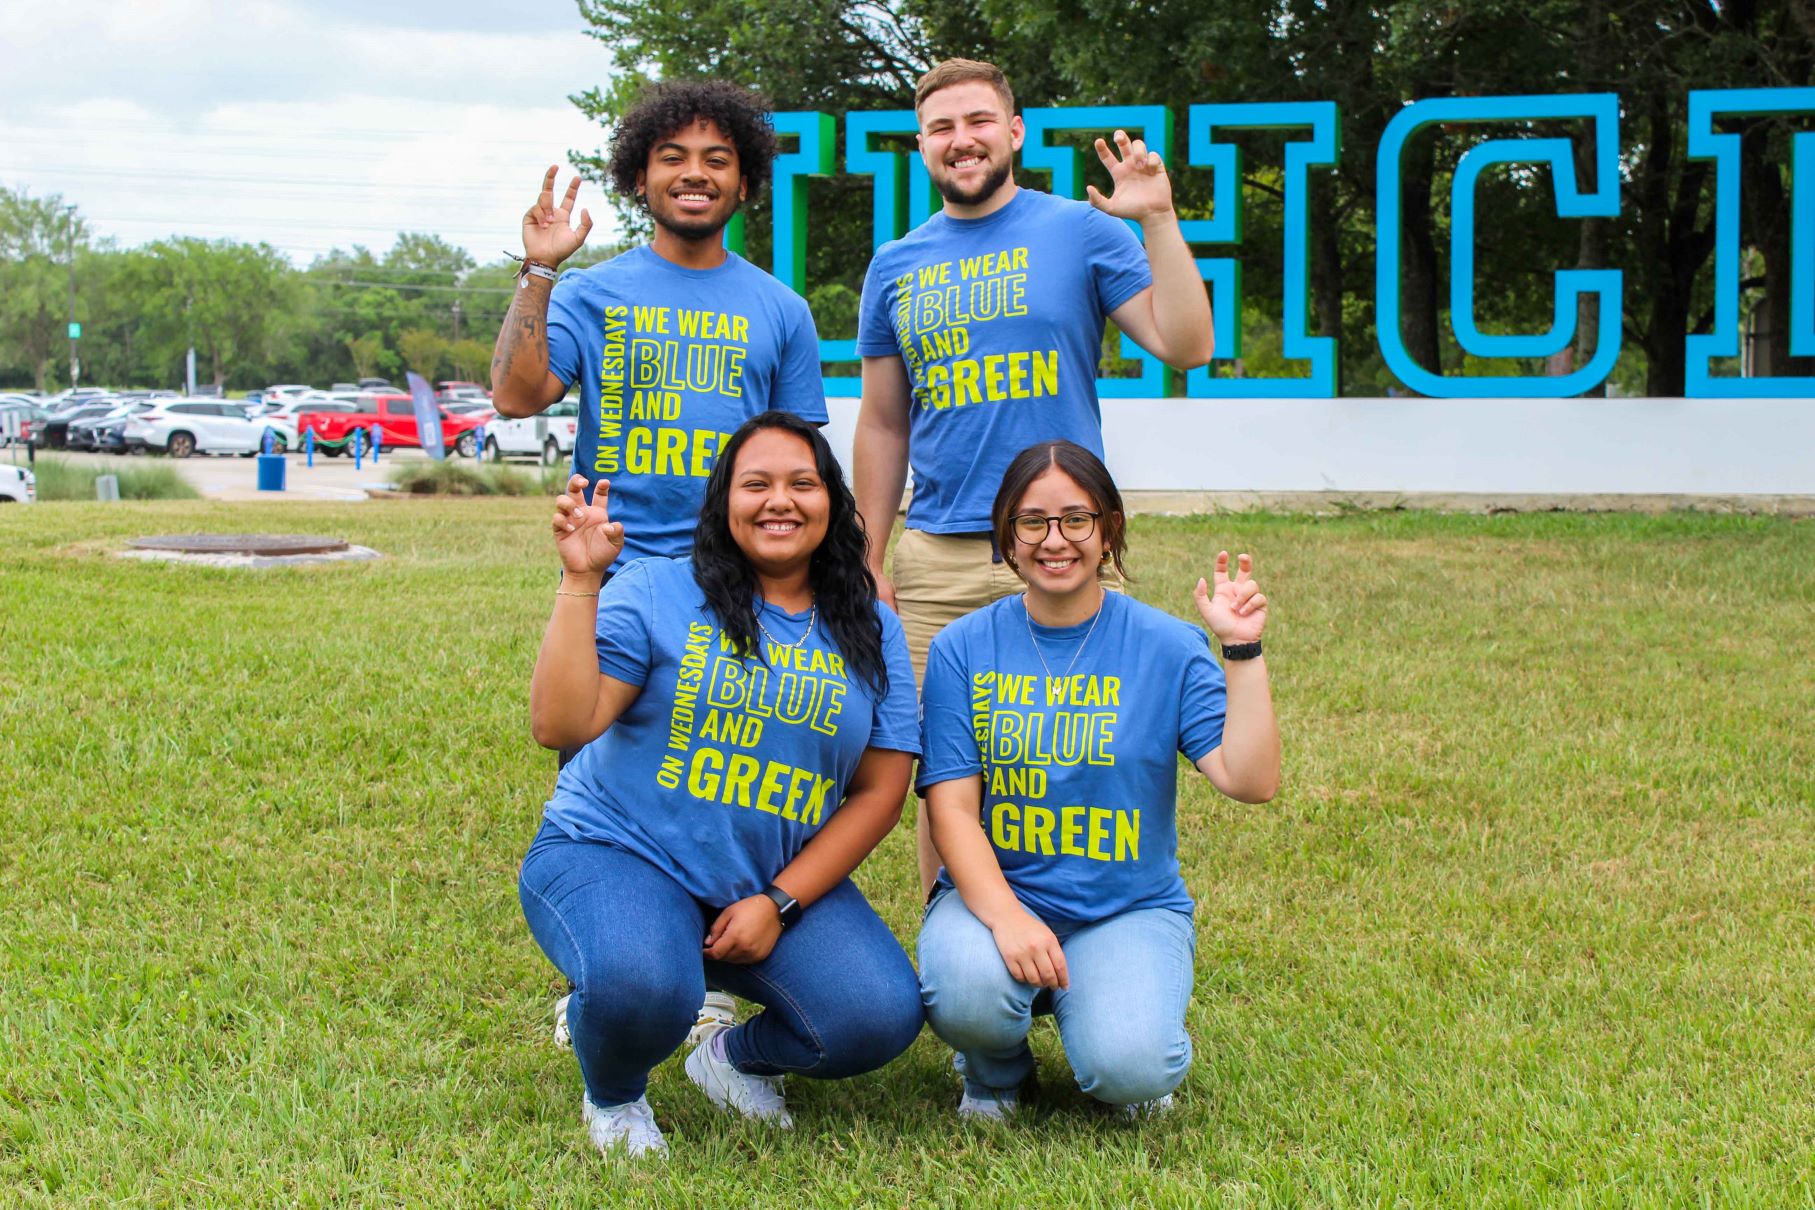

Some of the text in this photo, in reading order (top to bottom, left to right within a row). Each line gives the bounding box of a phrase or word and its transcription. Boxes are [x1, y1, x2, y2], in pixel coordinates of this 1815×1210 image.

[918, 247, 1029, 290] WE WEAR
[633, 305, 749, 344] WE WEAR
[914, 273, 1029, 335] BLUE
[629, 338, 747, 399] BLUE
[920, 326, 970, 363] AND
[594, 305, 629, 474] ON WEDNESDAYS
[629, 390, 686, 422] AND
[926, 350, 1059, 411] GREEN
[625, 426, 735, 478] GRE
[767, 642, 848, 679] WEAR
[656, 621, 714, 790] ON WEDNESDAYS
[706, 656, 848, 737] BLUE
[997, 672, 1121, 707] WE WEAR
[698, 708, 765, 748] AND
[990, 709, 1118, 767] BLUE
[990, 766, 1048, 799] AND
[991, 802, 1141, 862] GREEN
